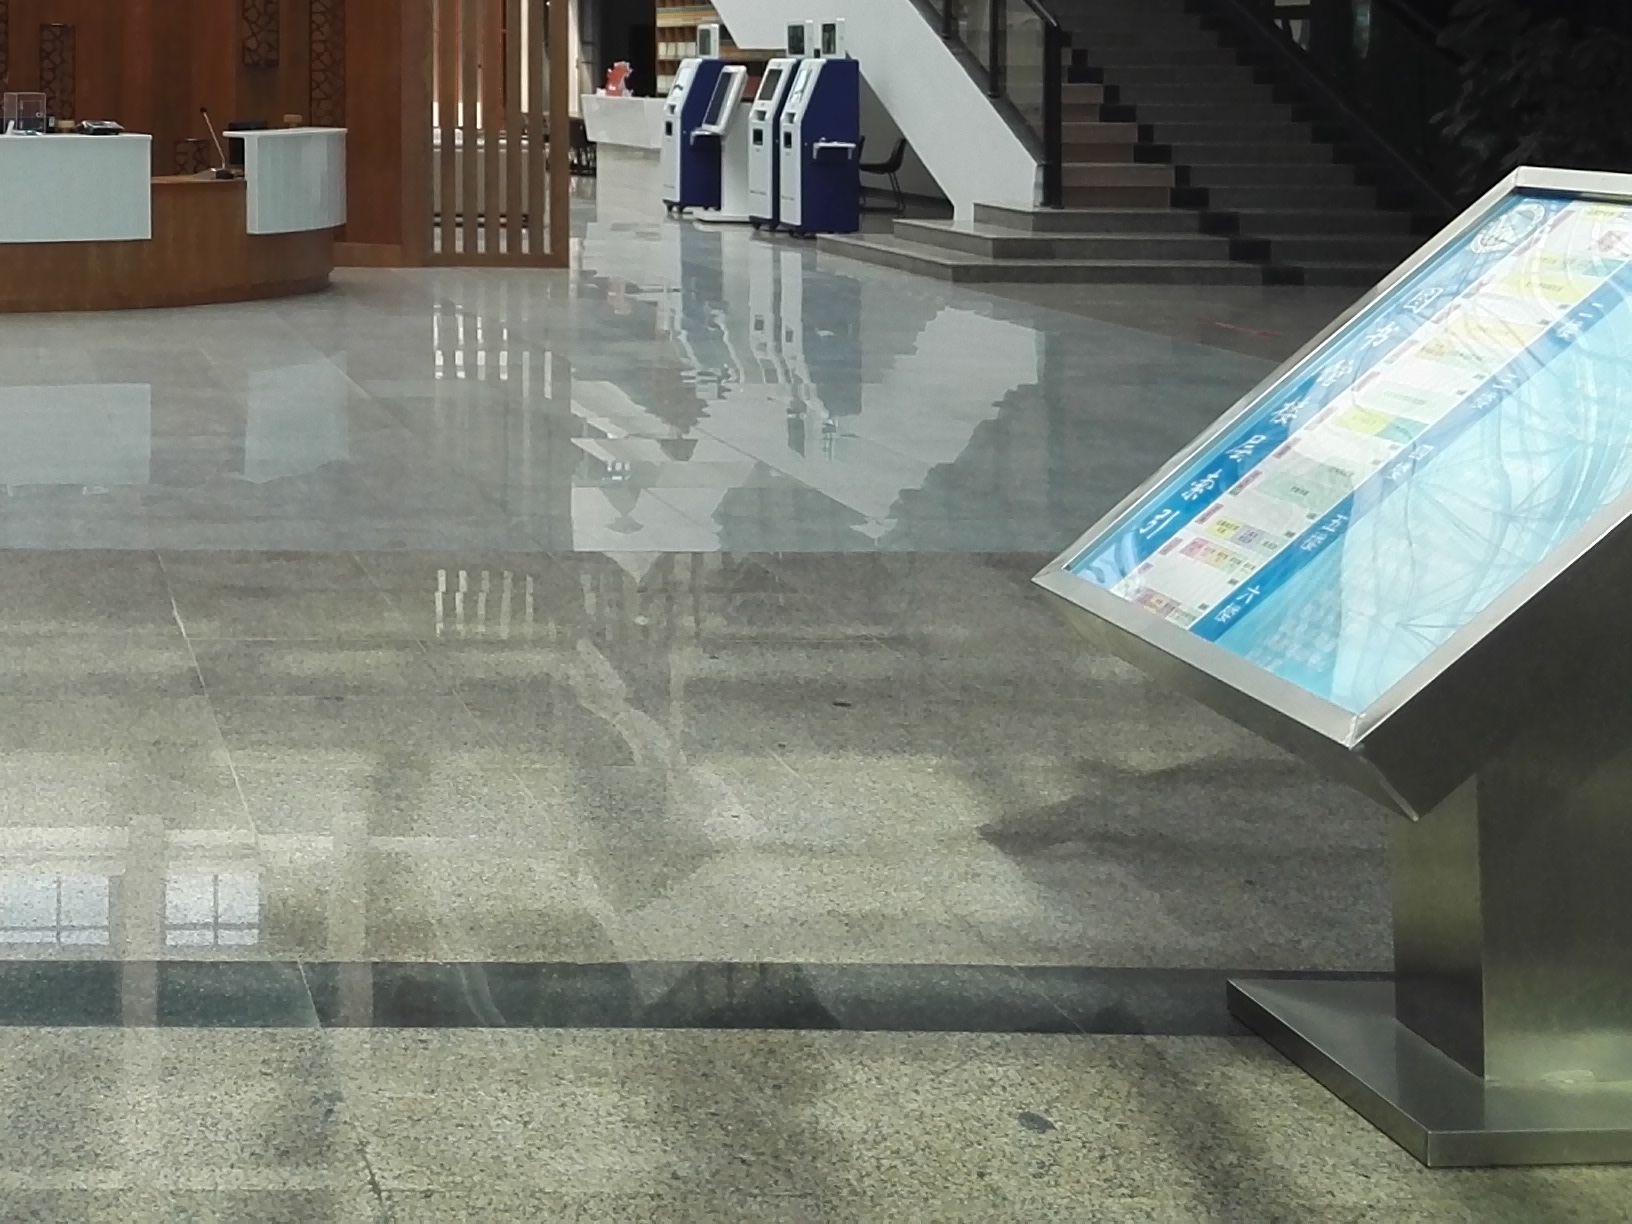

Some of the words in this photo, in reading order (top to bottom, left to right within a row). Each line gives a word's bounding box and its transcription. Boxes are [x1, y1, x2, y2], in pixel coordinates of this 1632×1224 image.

[1139, 287, 1443, 539] 图书馆楼层索引
[1214, 584, 1261, 624] 六楼
